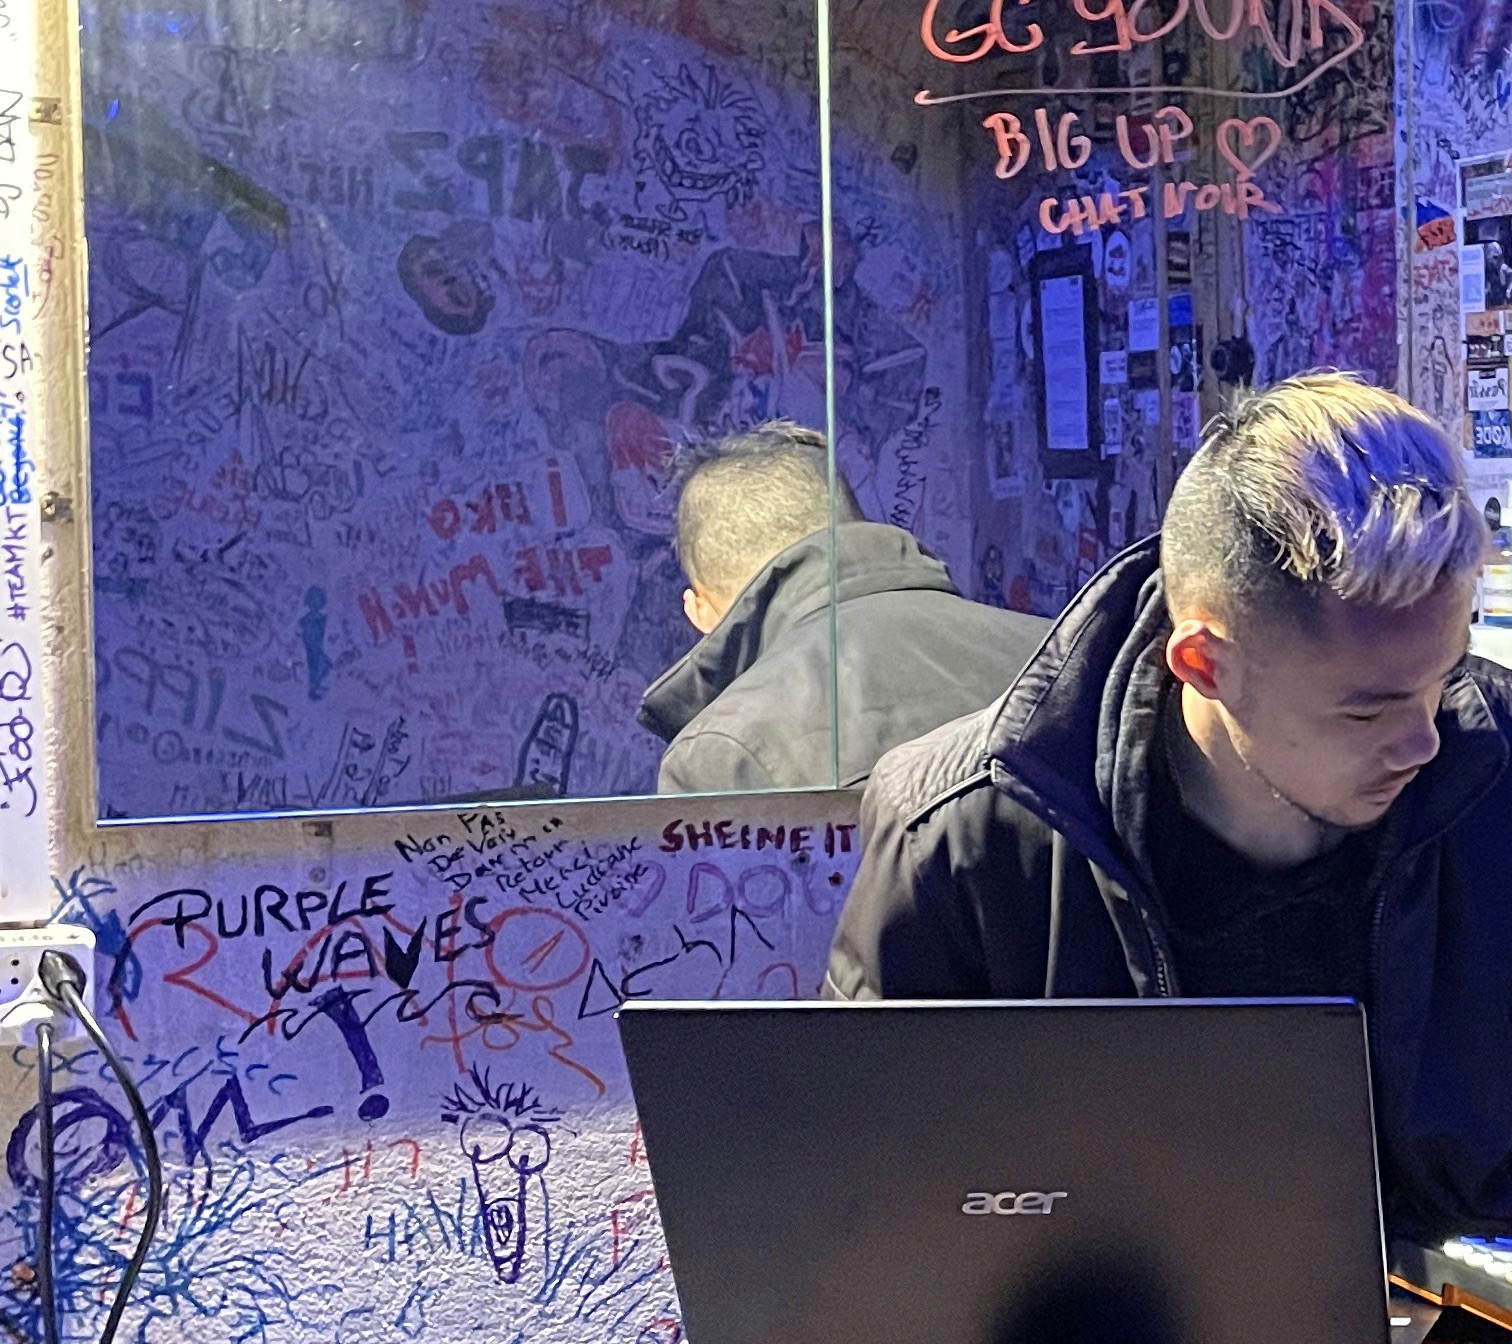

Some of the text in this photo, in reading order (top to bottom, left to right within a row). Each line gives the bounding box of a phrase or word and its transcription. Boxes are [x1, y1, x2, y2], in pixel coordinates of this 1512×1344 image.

[983, 105, 1194, 180] BIG UP
[1040, 181, 1281, 237] CHAT NOIR
[130, 870, 395, 949] PURPLE
[262, 897, 497, 995] WAVES
[961, 1191, 1068, 1215] acer
